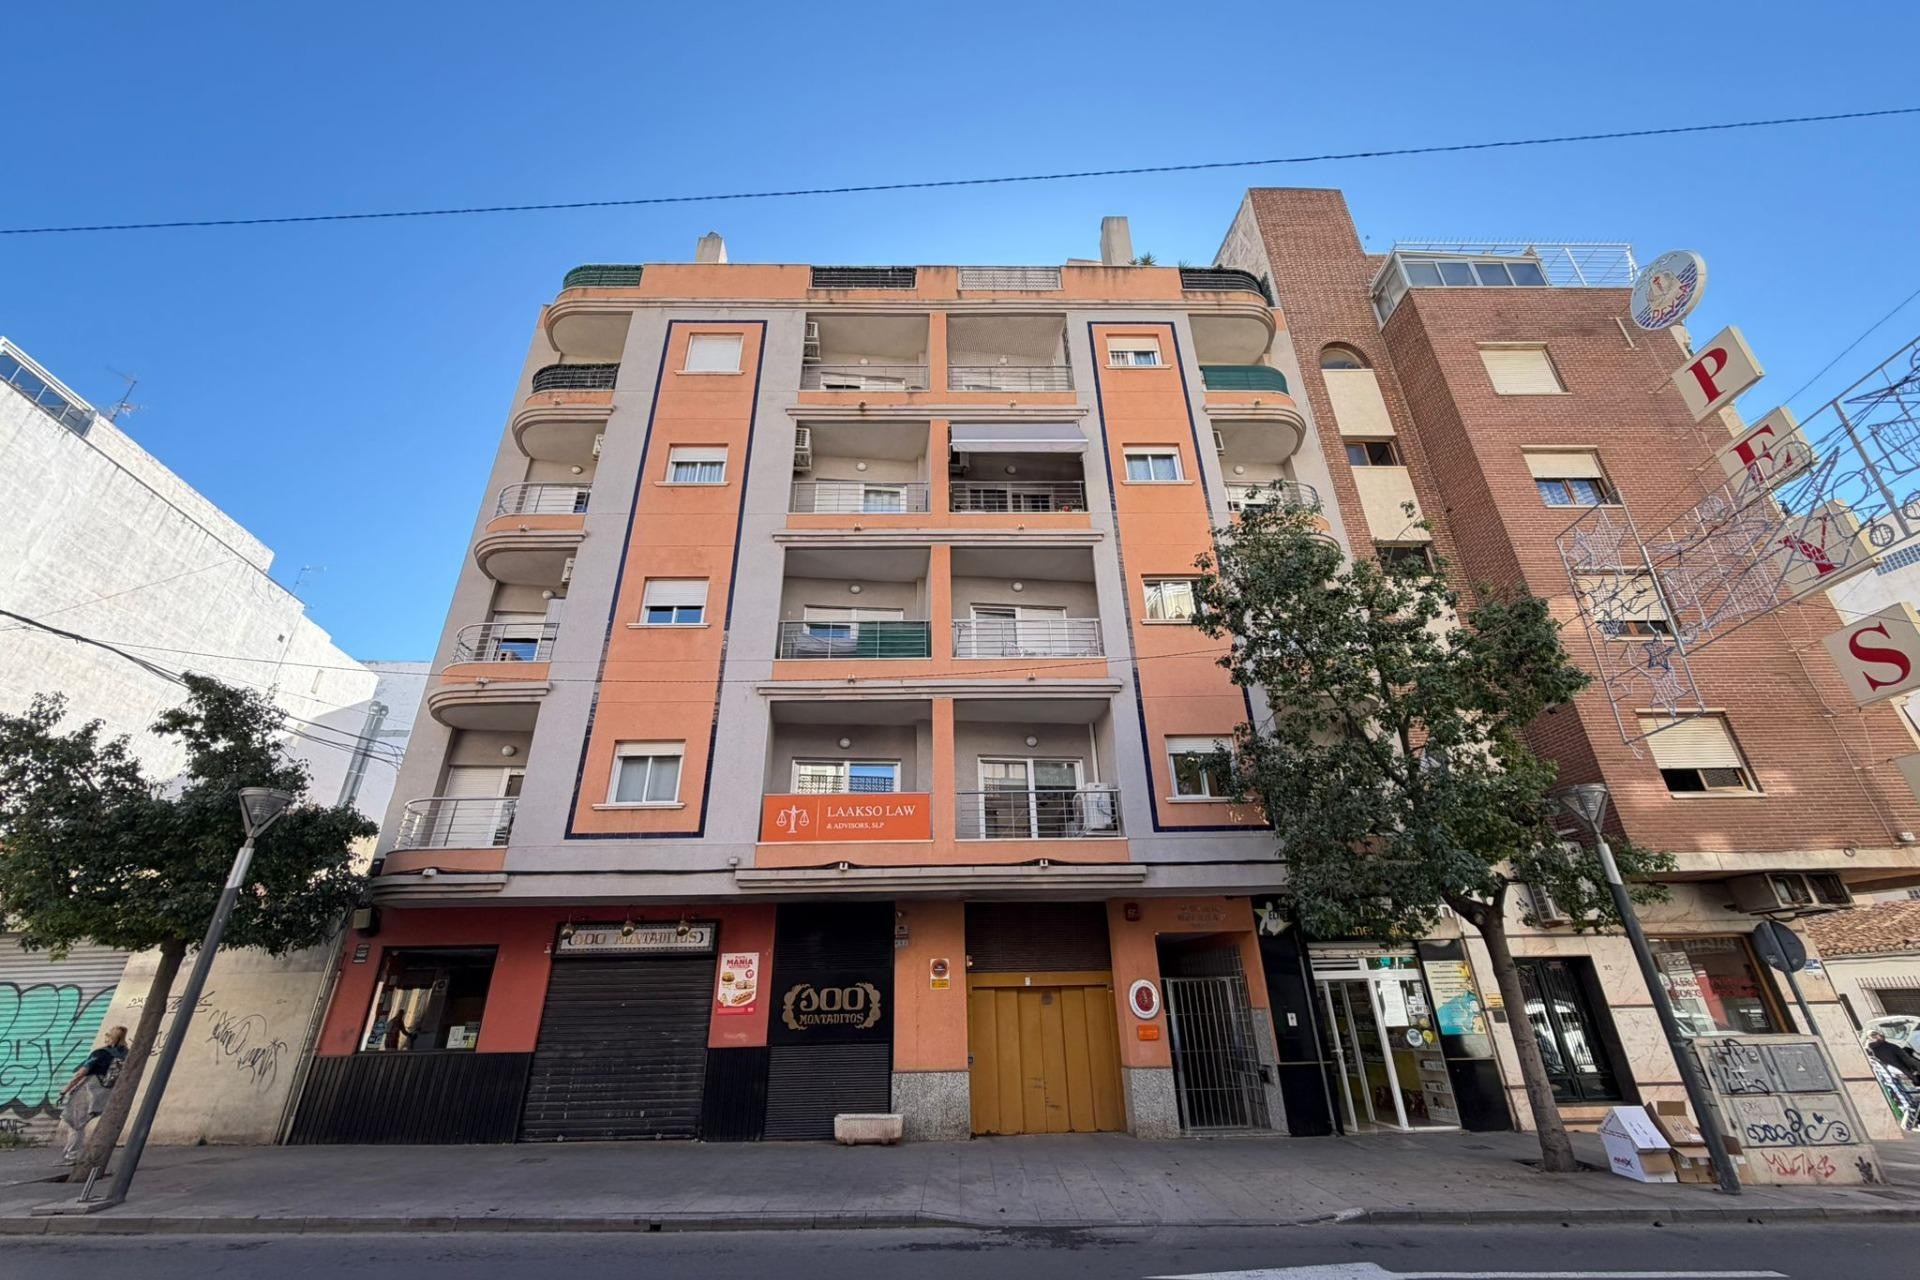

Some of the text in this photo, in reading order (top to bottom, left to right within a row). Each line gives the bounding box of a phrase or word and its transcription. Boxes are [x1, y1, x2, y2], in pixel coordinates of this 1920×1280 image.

[827, 805, 915, 817] LAAKSO LAW
[799, 1013, 864, 1025] MONTADITOS
